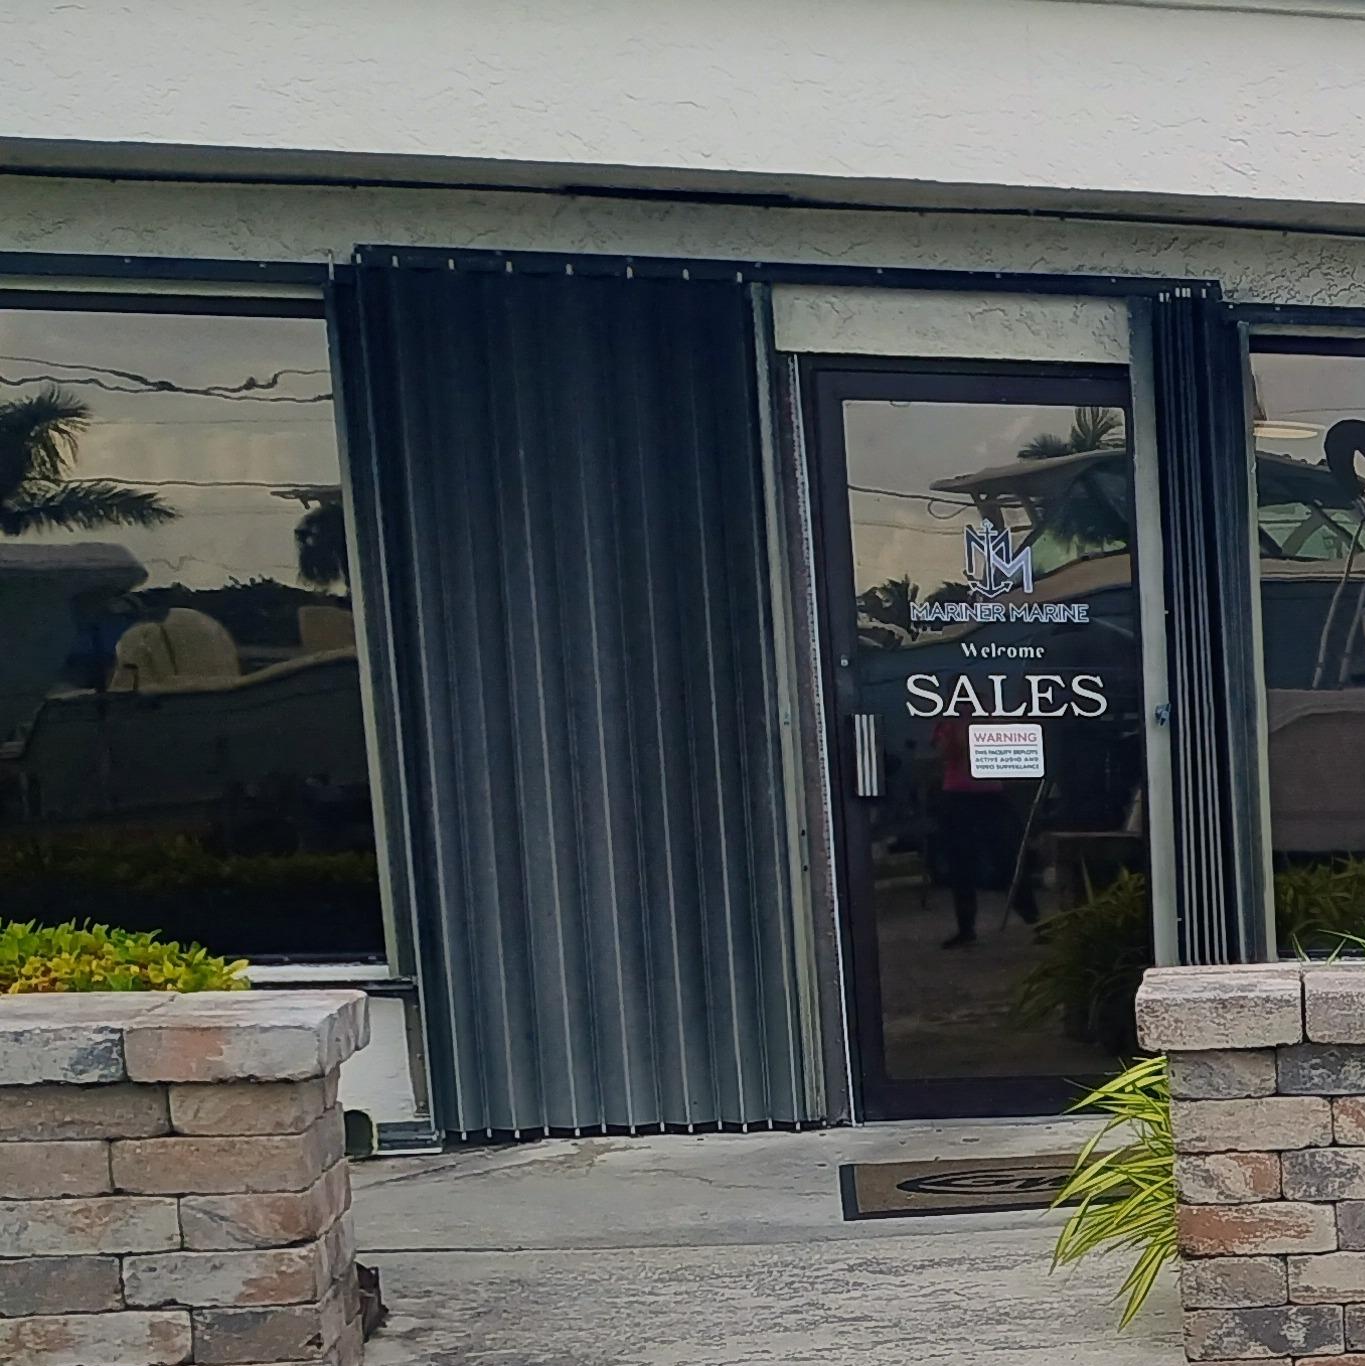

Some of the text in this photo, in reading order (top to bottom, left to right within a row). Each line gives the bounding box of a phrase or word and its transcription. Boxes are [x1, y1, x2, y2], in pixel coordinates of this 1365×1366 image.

[910, 602, 1090, 623] MARINER MARINE
[961, 643, 1045, 659] Welcome
[906, 674, 1108, 718] SALES
[973, 732, 1038, 743] WARNING
